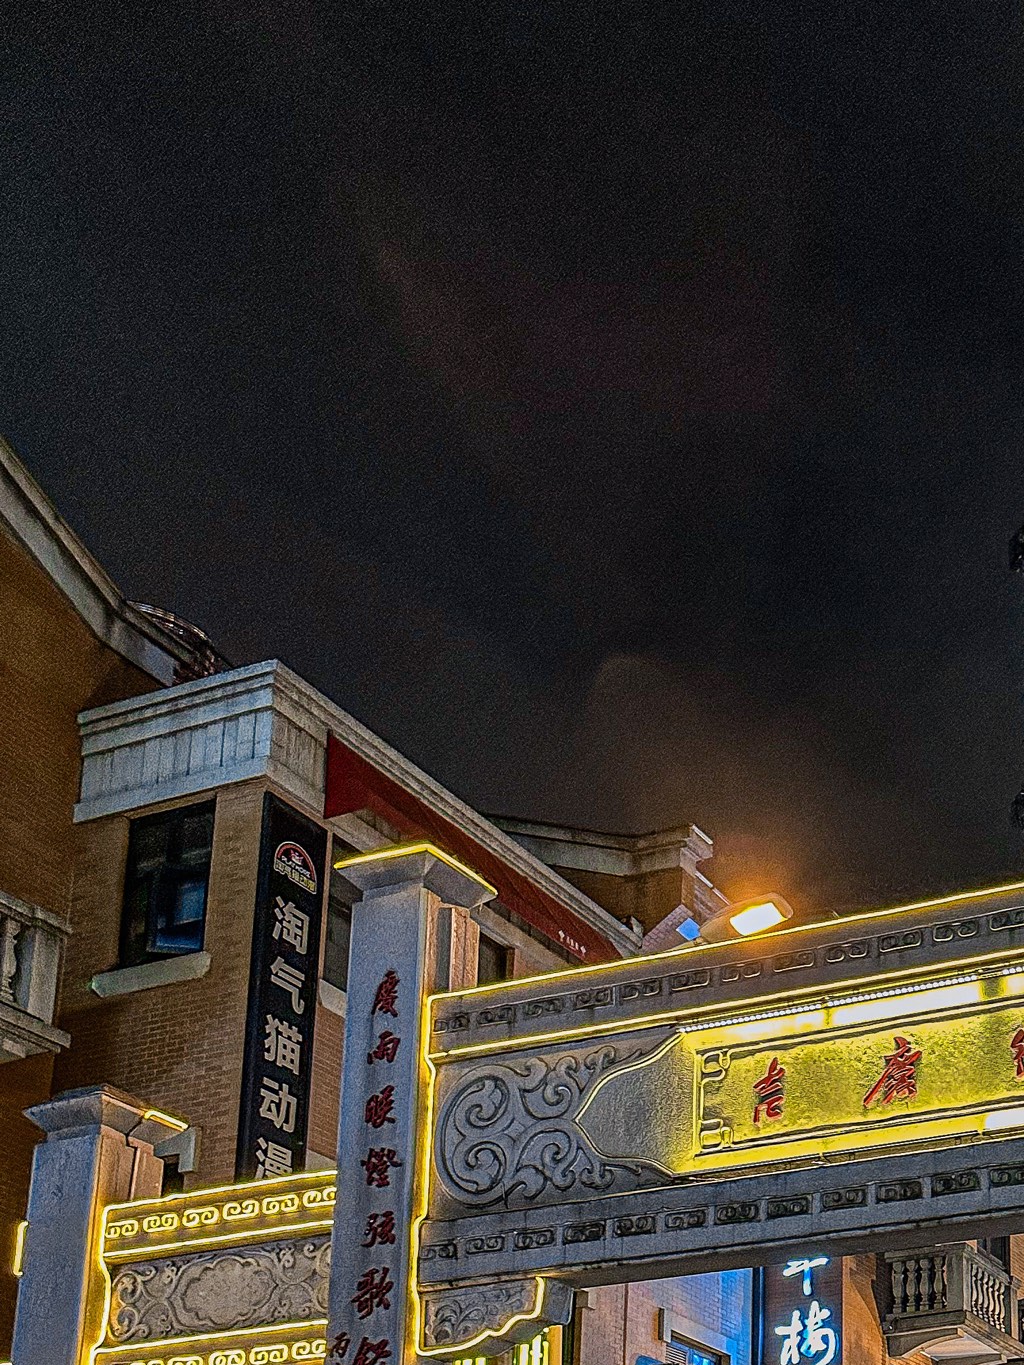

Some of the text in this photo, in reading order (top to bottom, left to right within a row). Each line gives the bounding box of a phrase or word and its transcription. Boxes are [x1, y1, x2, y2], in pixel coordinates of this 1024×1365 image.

[255, 896, 310, 1178] 淘气猫动漫
